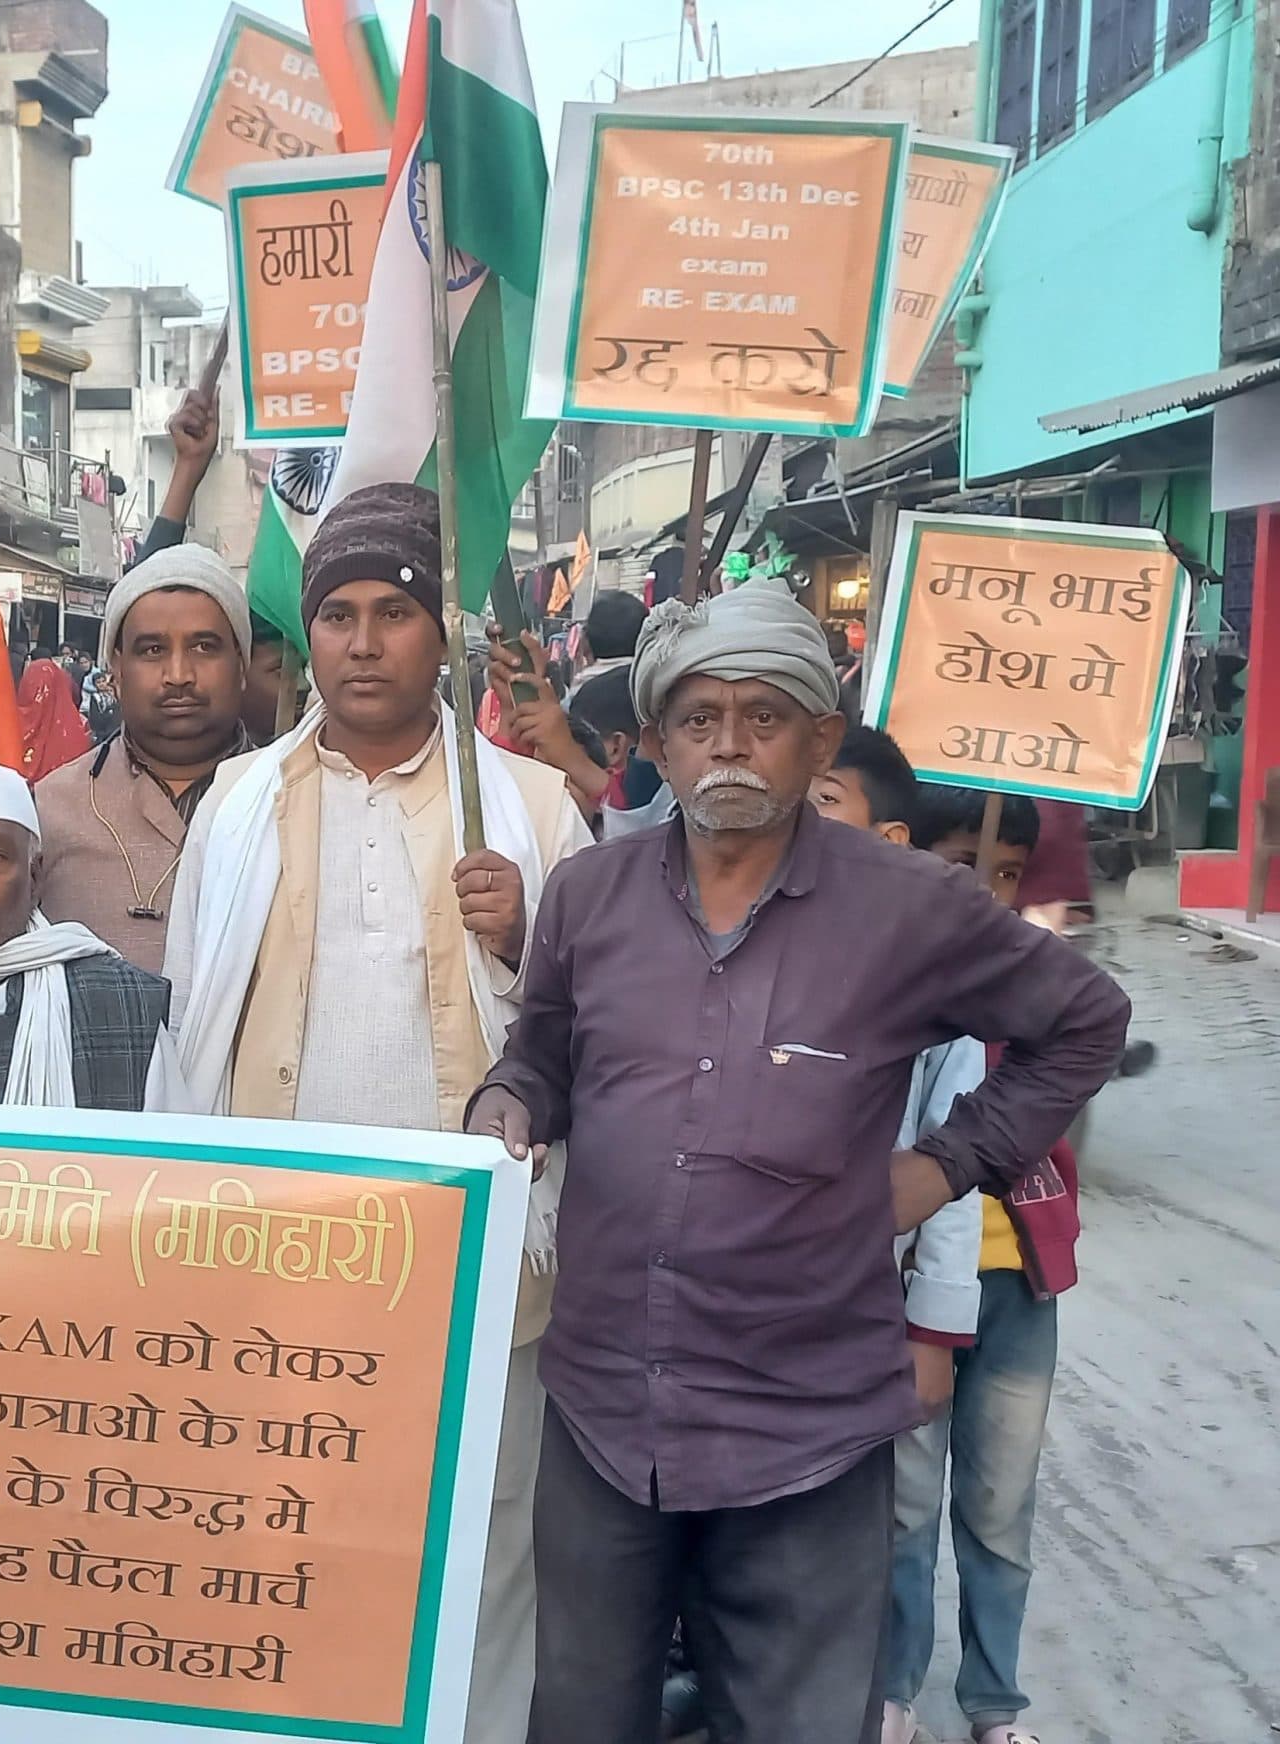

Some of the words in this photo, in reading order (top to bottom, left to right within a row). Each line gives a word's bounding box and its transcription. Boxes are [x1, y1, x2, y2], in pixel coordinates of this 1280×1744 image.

[282, 54, 320, 80] BP
[703, 143, 774, 165] 70th
[617, 175, 704, 200] BPSC
[718, 180, 787, 203] 13th
[800, 184, 860, 206] Dec
[256, 199, 354, 286] हमारी
[669, 215, 720, 238] 4th
[731, 219, 790, 240] Jan
[681, 257, 768, 277] exam
[308, 302, 368, 330] 70
[640, 288, 693, 309] RE-
[705, 291, 798, 315] EXAM
[707, 327, 847, 397] करो
[928, 561, 1043, 626] मनू
[1049, 567, 1161, 622] भाई
[935, 631, 1056, 690] होश
[1070, 643, 1125, 698] मे
[939, 721, 1090, 776] आओ
[130, 1169, 416, 1312] (मनिहारी)
[134, 1320, 220, 1372] को
[232, 1325, 386, 1386] लेकर
[178, 1397, 245, 1449] के
[256, 1411, 366, 1463] प्रति
[6, 1456, 71, 1508] के
[83, 1466, 253, 1536] विरुद्ध
[265, 1483, 315, 1536] मे
[47, 1537, 182, 1597] पैदल
[200, 1561, 316, 1610] मार्च
[64, 1620, 293, 1684] मनिहारी
